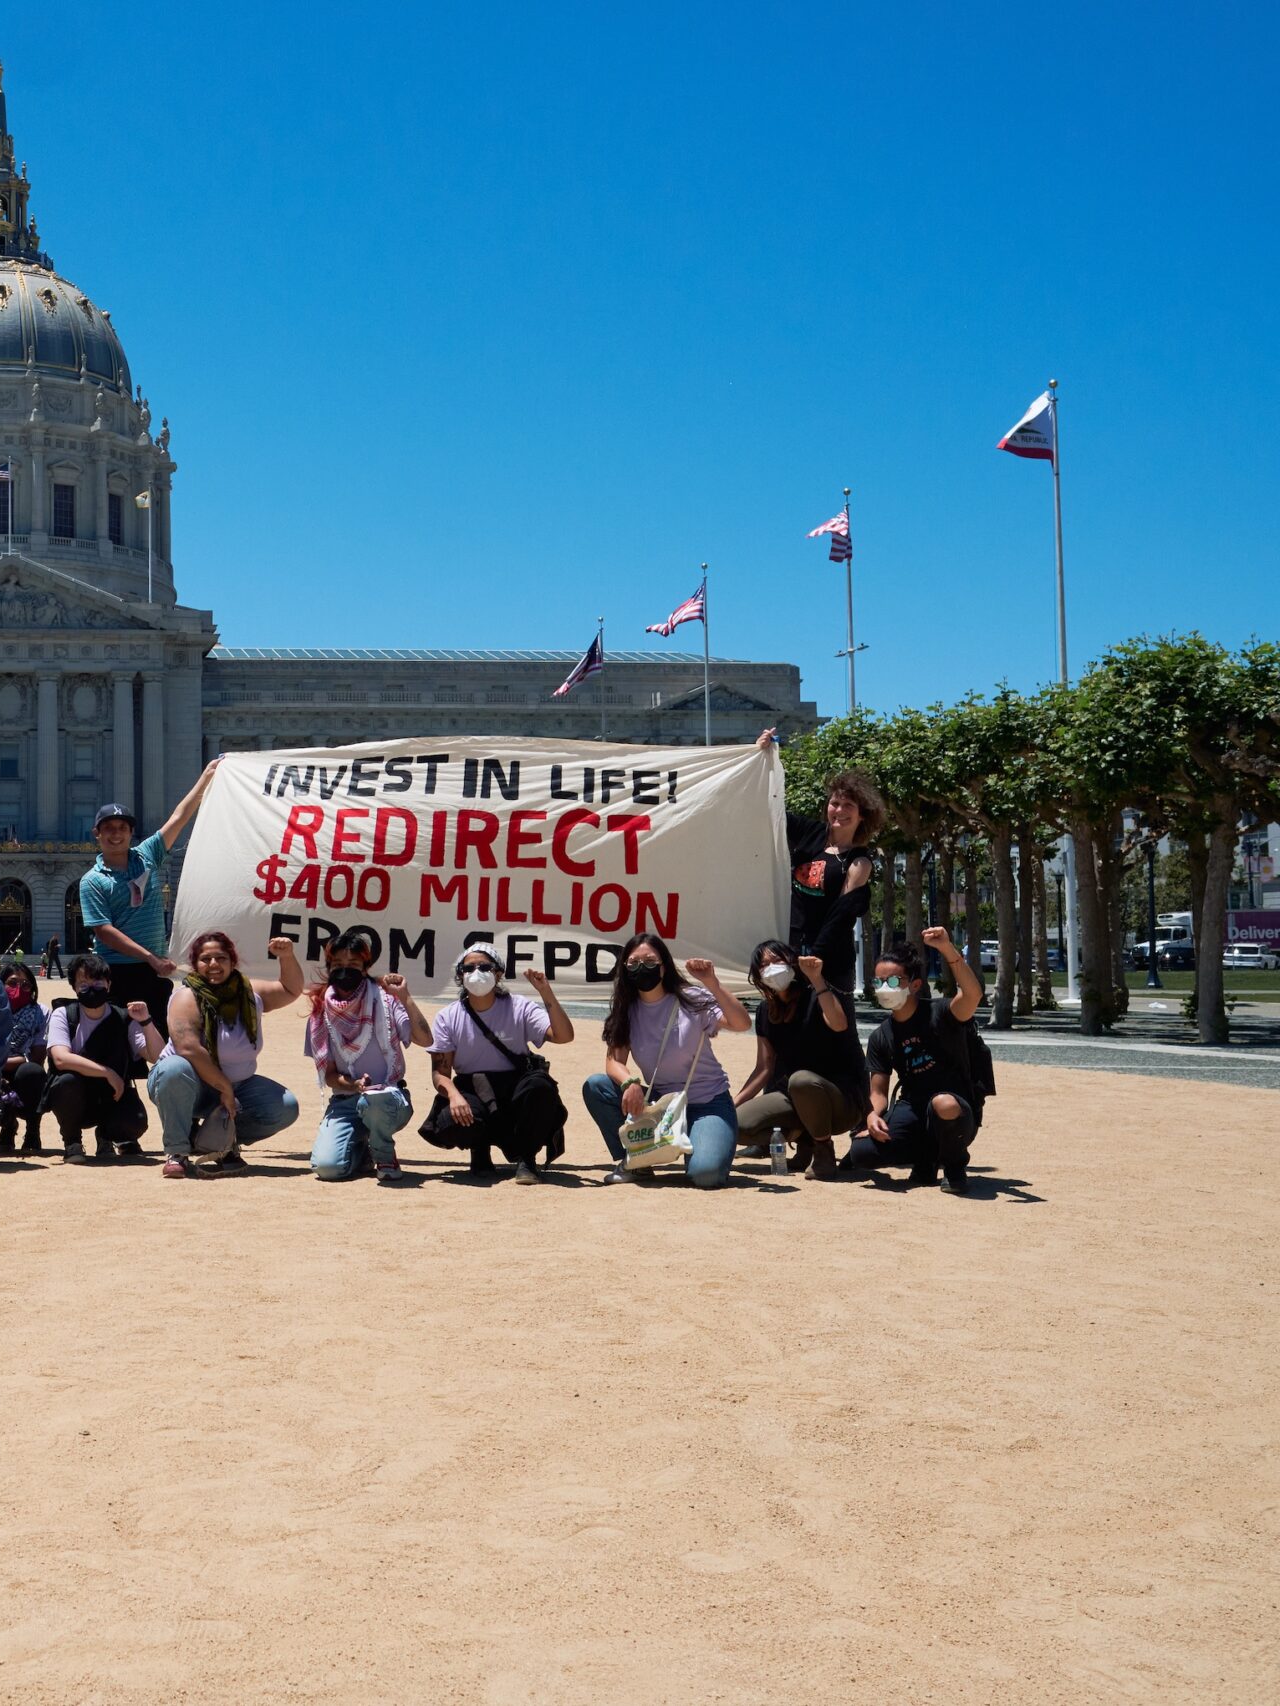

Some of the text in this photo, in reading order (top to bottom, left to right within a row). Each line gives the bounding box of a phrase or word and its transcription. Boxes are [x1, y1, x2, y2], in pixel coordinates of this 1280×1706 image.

[264, 755, 677, 803] INVEST IN LIFE!
[282, 806, 651, 877] REDIRECT
[254, 855, 679, 939] $400 MILLION
[1227, 926, 1280, 939] Deliver
[627, 1128, 653, 1140] CARE
